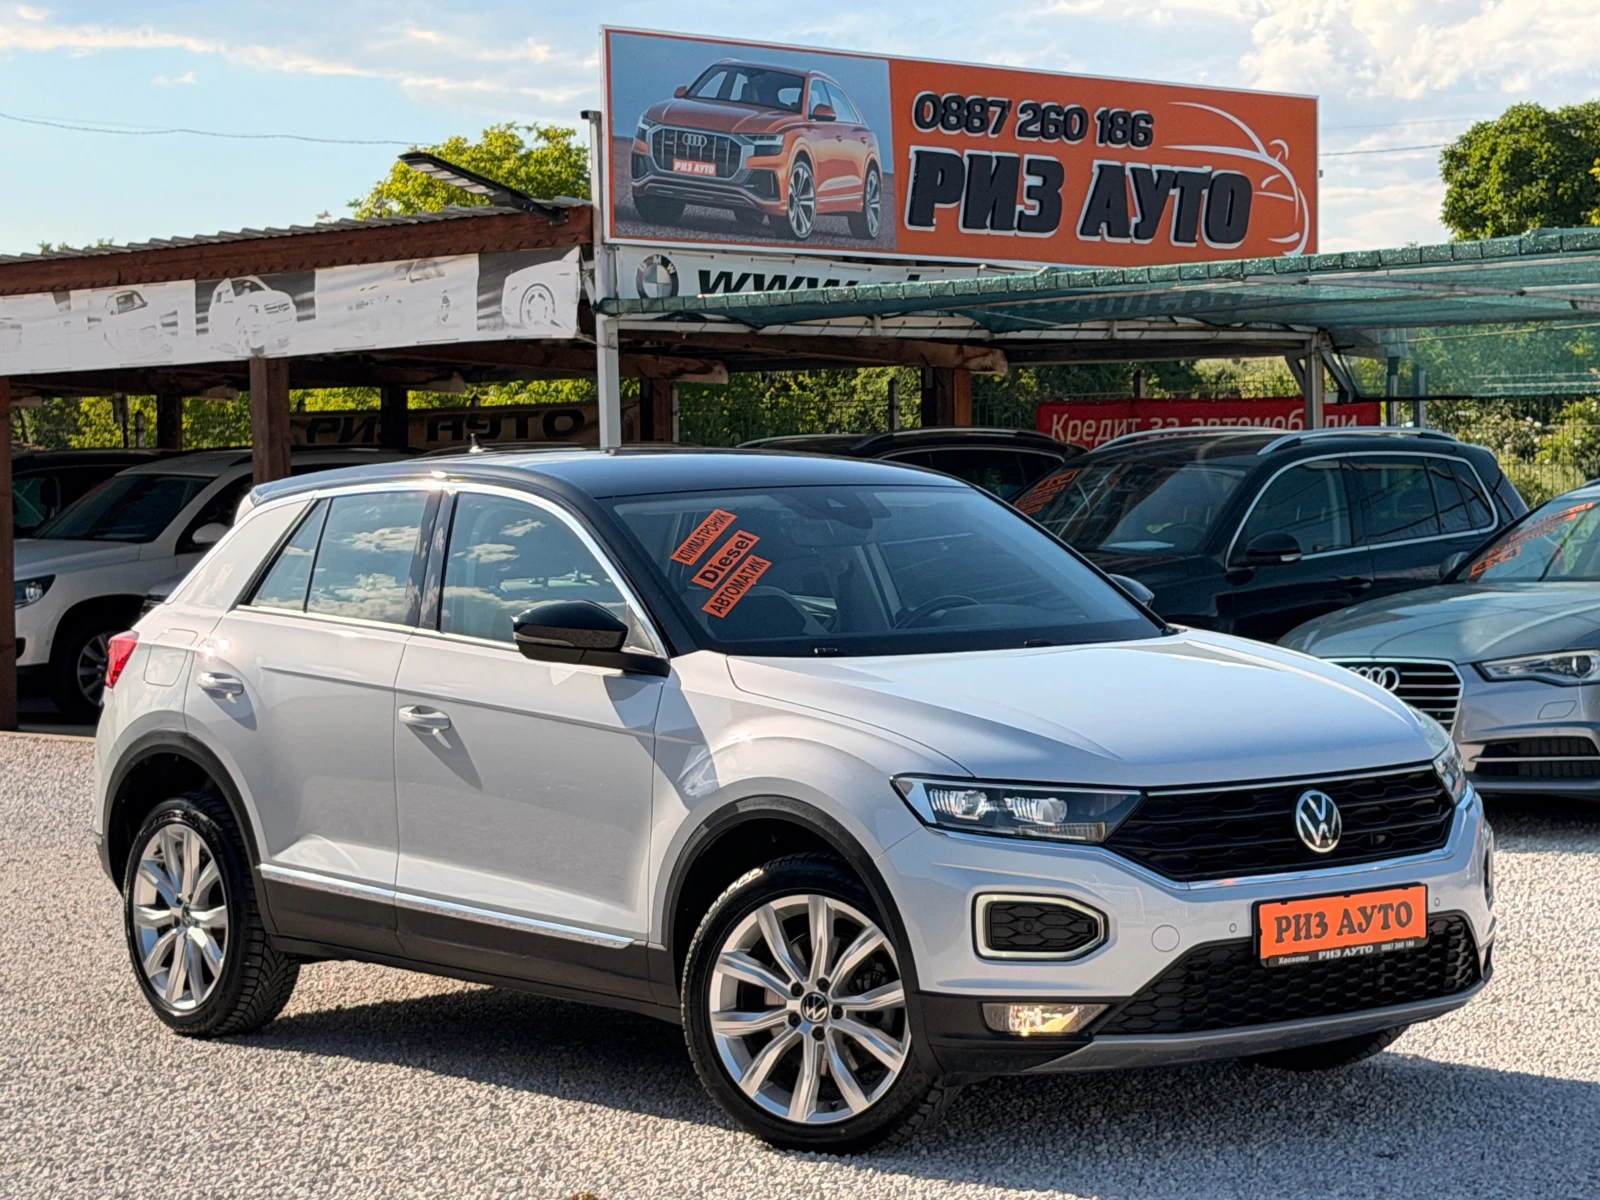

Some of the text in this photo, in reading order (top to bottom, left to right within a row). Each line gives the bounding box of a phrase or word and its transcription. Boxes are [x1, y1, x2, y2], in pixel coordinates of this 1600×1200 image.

[913, 91, 1154, 149] 0887 260 186
[675, 161, 715, 175] РИЗ АУТО
[904, 146, 1253, 249] РИЗ АУТО
[306, 408, 585, 444] РИ АУТО
[1051, 413, 1142, 446] Кредит
[699, 533, 755, 583] Diesel
[710, 558, 768, 614] АВТОМАТИК
[1274, 901, 1413, 943] РИЗ АУТО
[1319, 949, 1342, 960] РИЗ
[1343, 945, 1374, 957] АУТО
